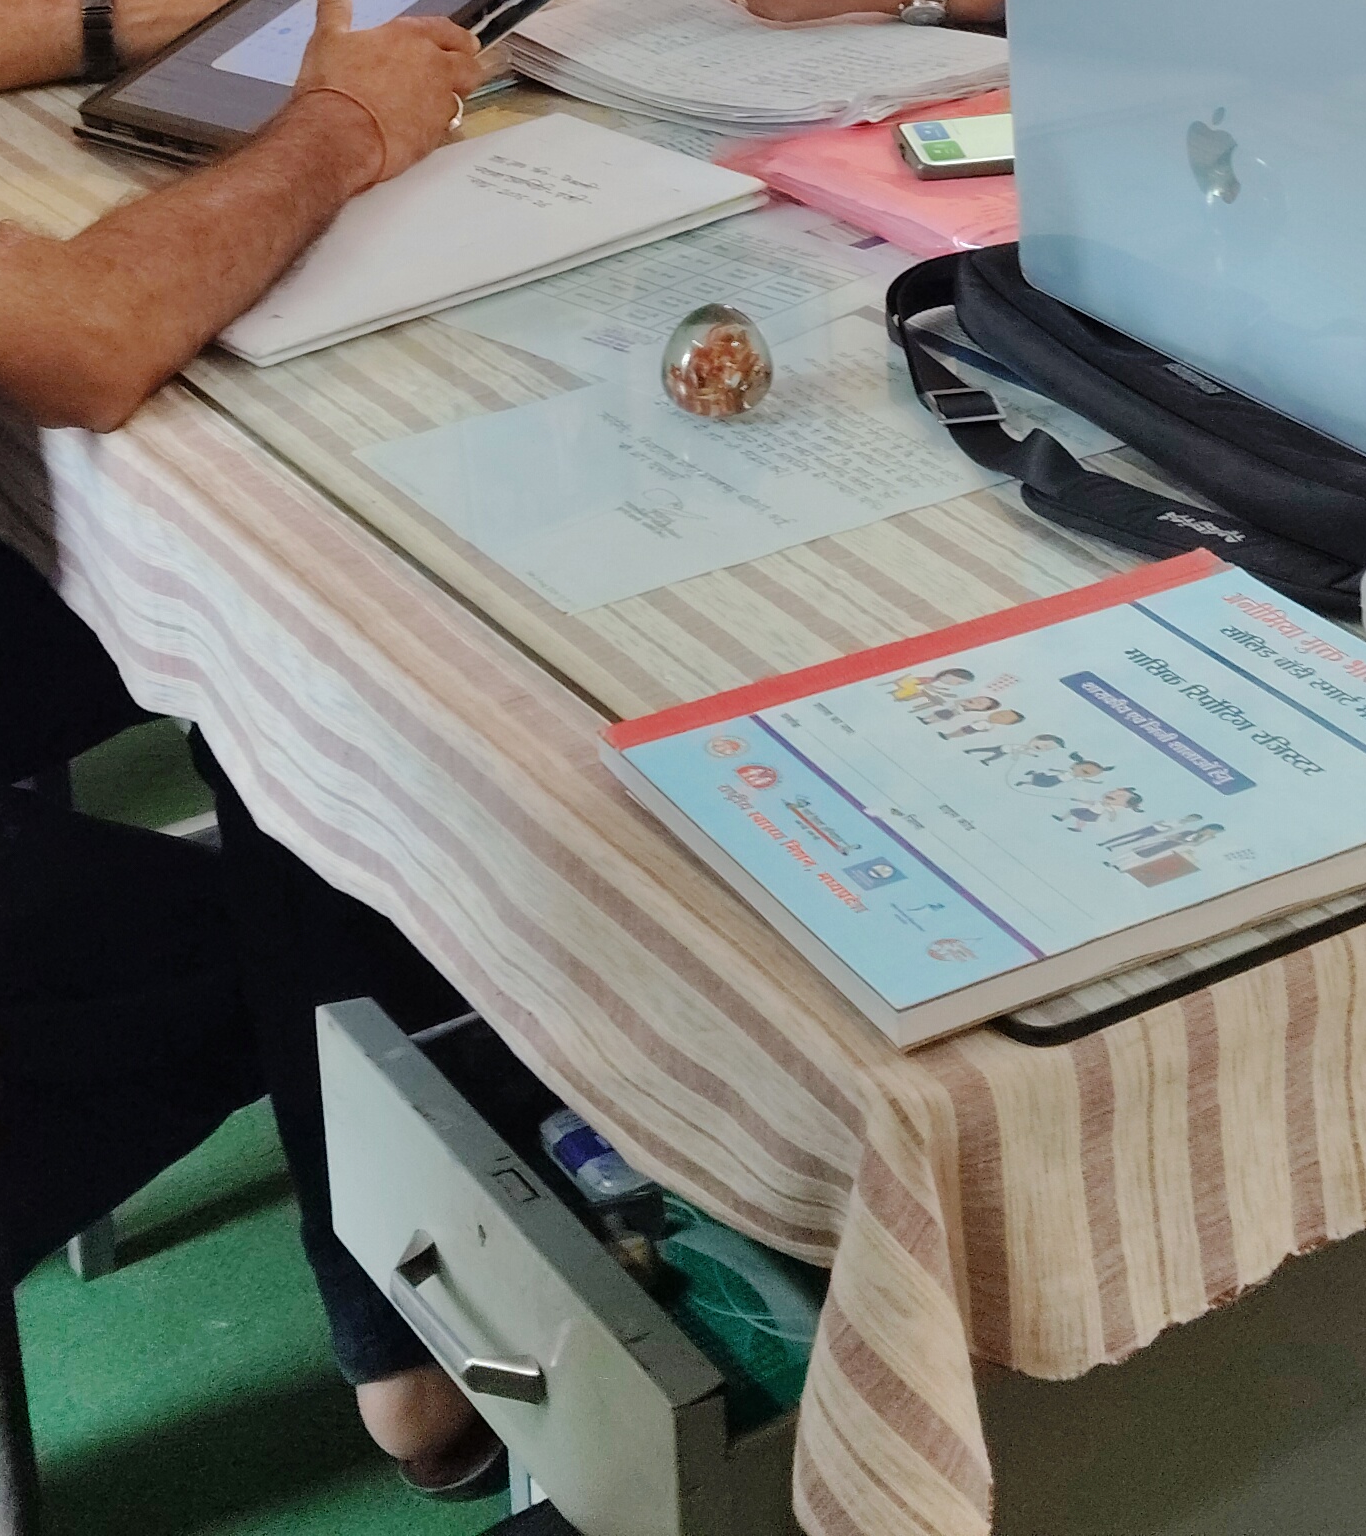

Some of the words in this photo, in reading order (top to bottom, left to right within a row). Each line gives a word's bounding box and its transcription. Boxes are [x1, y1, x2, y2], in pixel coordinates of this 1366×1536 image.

[1219, 625, 1277, 658] सॉलिड
[1308, 677, 1365, 706] स्मार्ट
[1222, 592, 1306, 638] अनीमिया
[1293, 635, 1349, 662] मुक्त
[1124, 648, 1186, 685] मासिक
[1250, 730, 1324, 775] रजिस्टर
